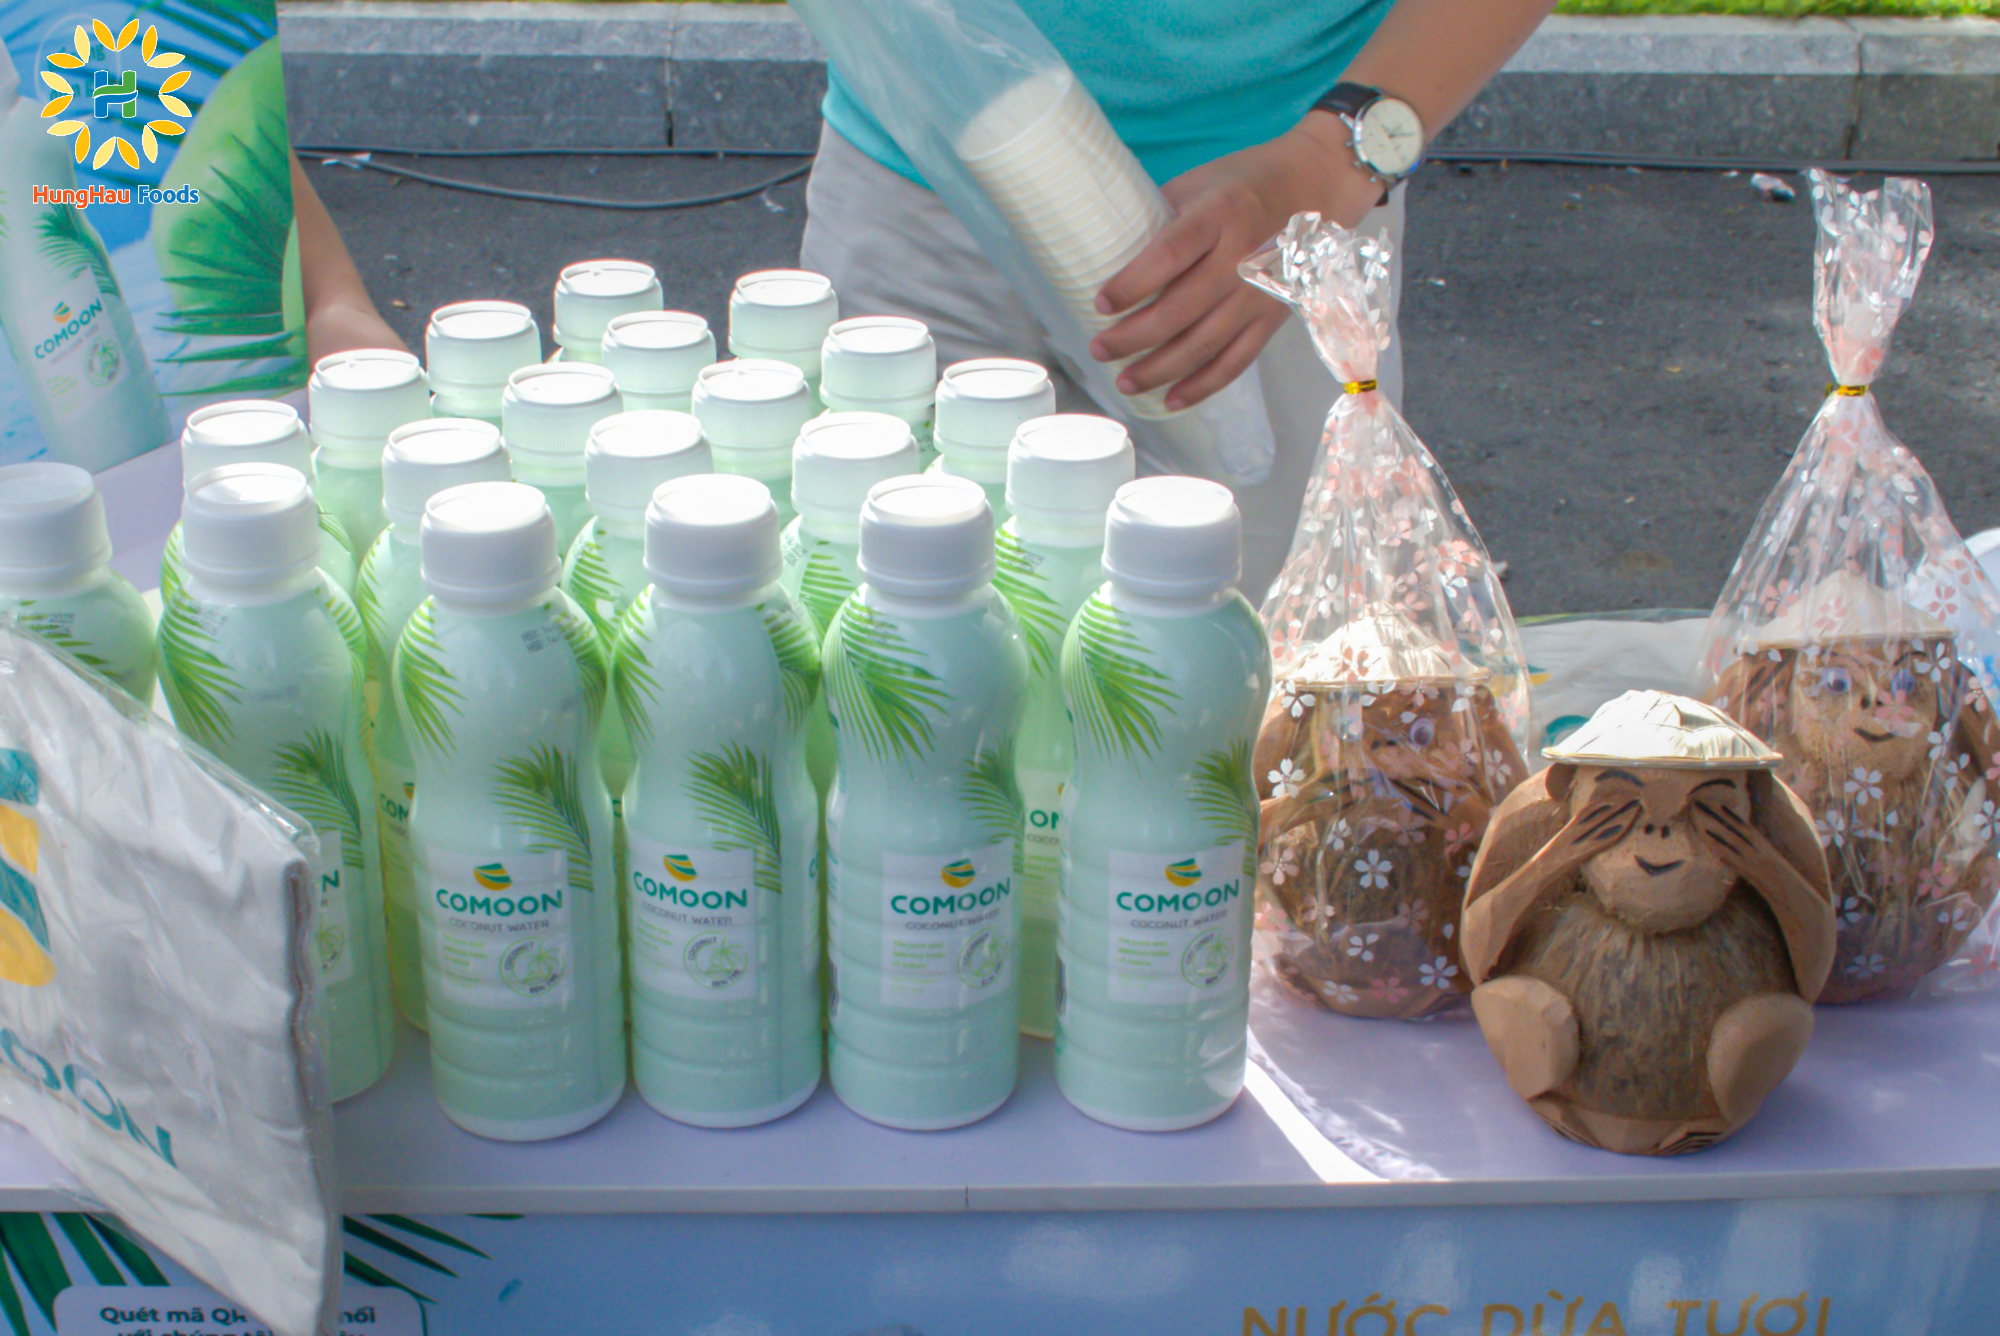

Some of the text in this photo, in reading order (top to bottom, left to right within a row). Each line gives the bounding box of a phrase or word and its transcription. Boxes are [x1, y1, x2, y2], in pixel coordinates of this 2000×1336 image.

[34, 298, 102, 359] COMOON
[436, 888, 563, 917] COMOON
[633, 871, 748, 909] COMOON
[890, 876, 1010, 915] COMOON
[1116, 878, 1240, 913] COMOON
[449, 917, 550, 933] COCONUT WATER
[642, 901, 733, 926] COCONUT WATER
[905, 918, 964, 931] COCONUT
[1130, 909, 1228, 930] COCONUT WATER
[688, 936, 718, 961] COCONUT
[100, 1306, 160, 1324] Quét
[166, 1306, 205, 1323] mã
[1242, 1289, 1831, 1336] NƯỚC DỪA TƯƠI
